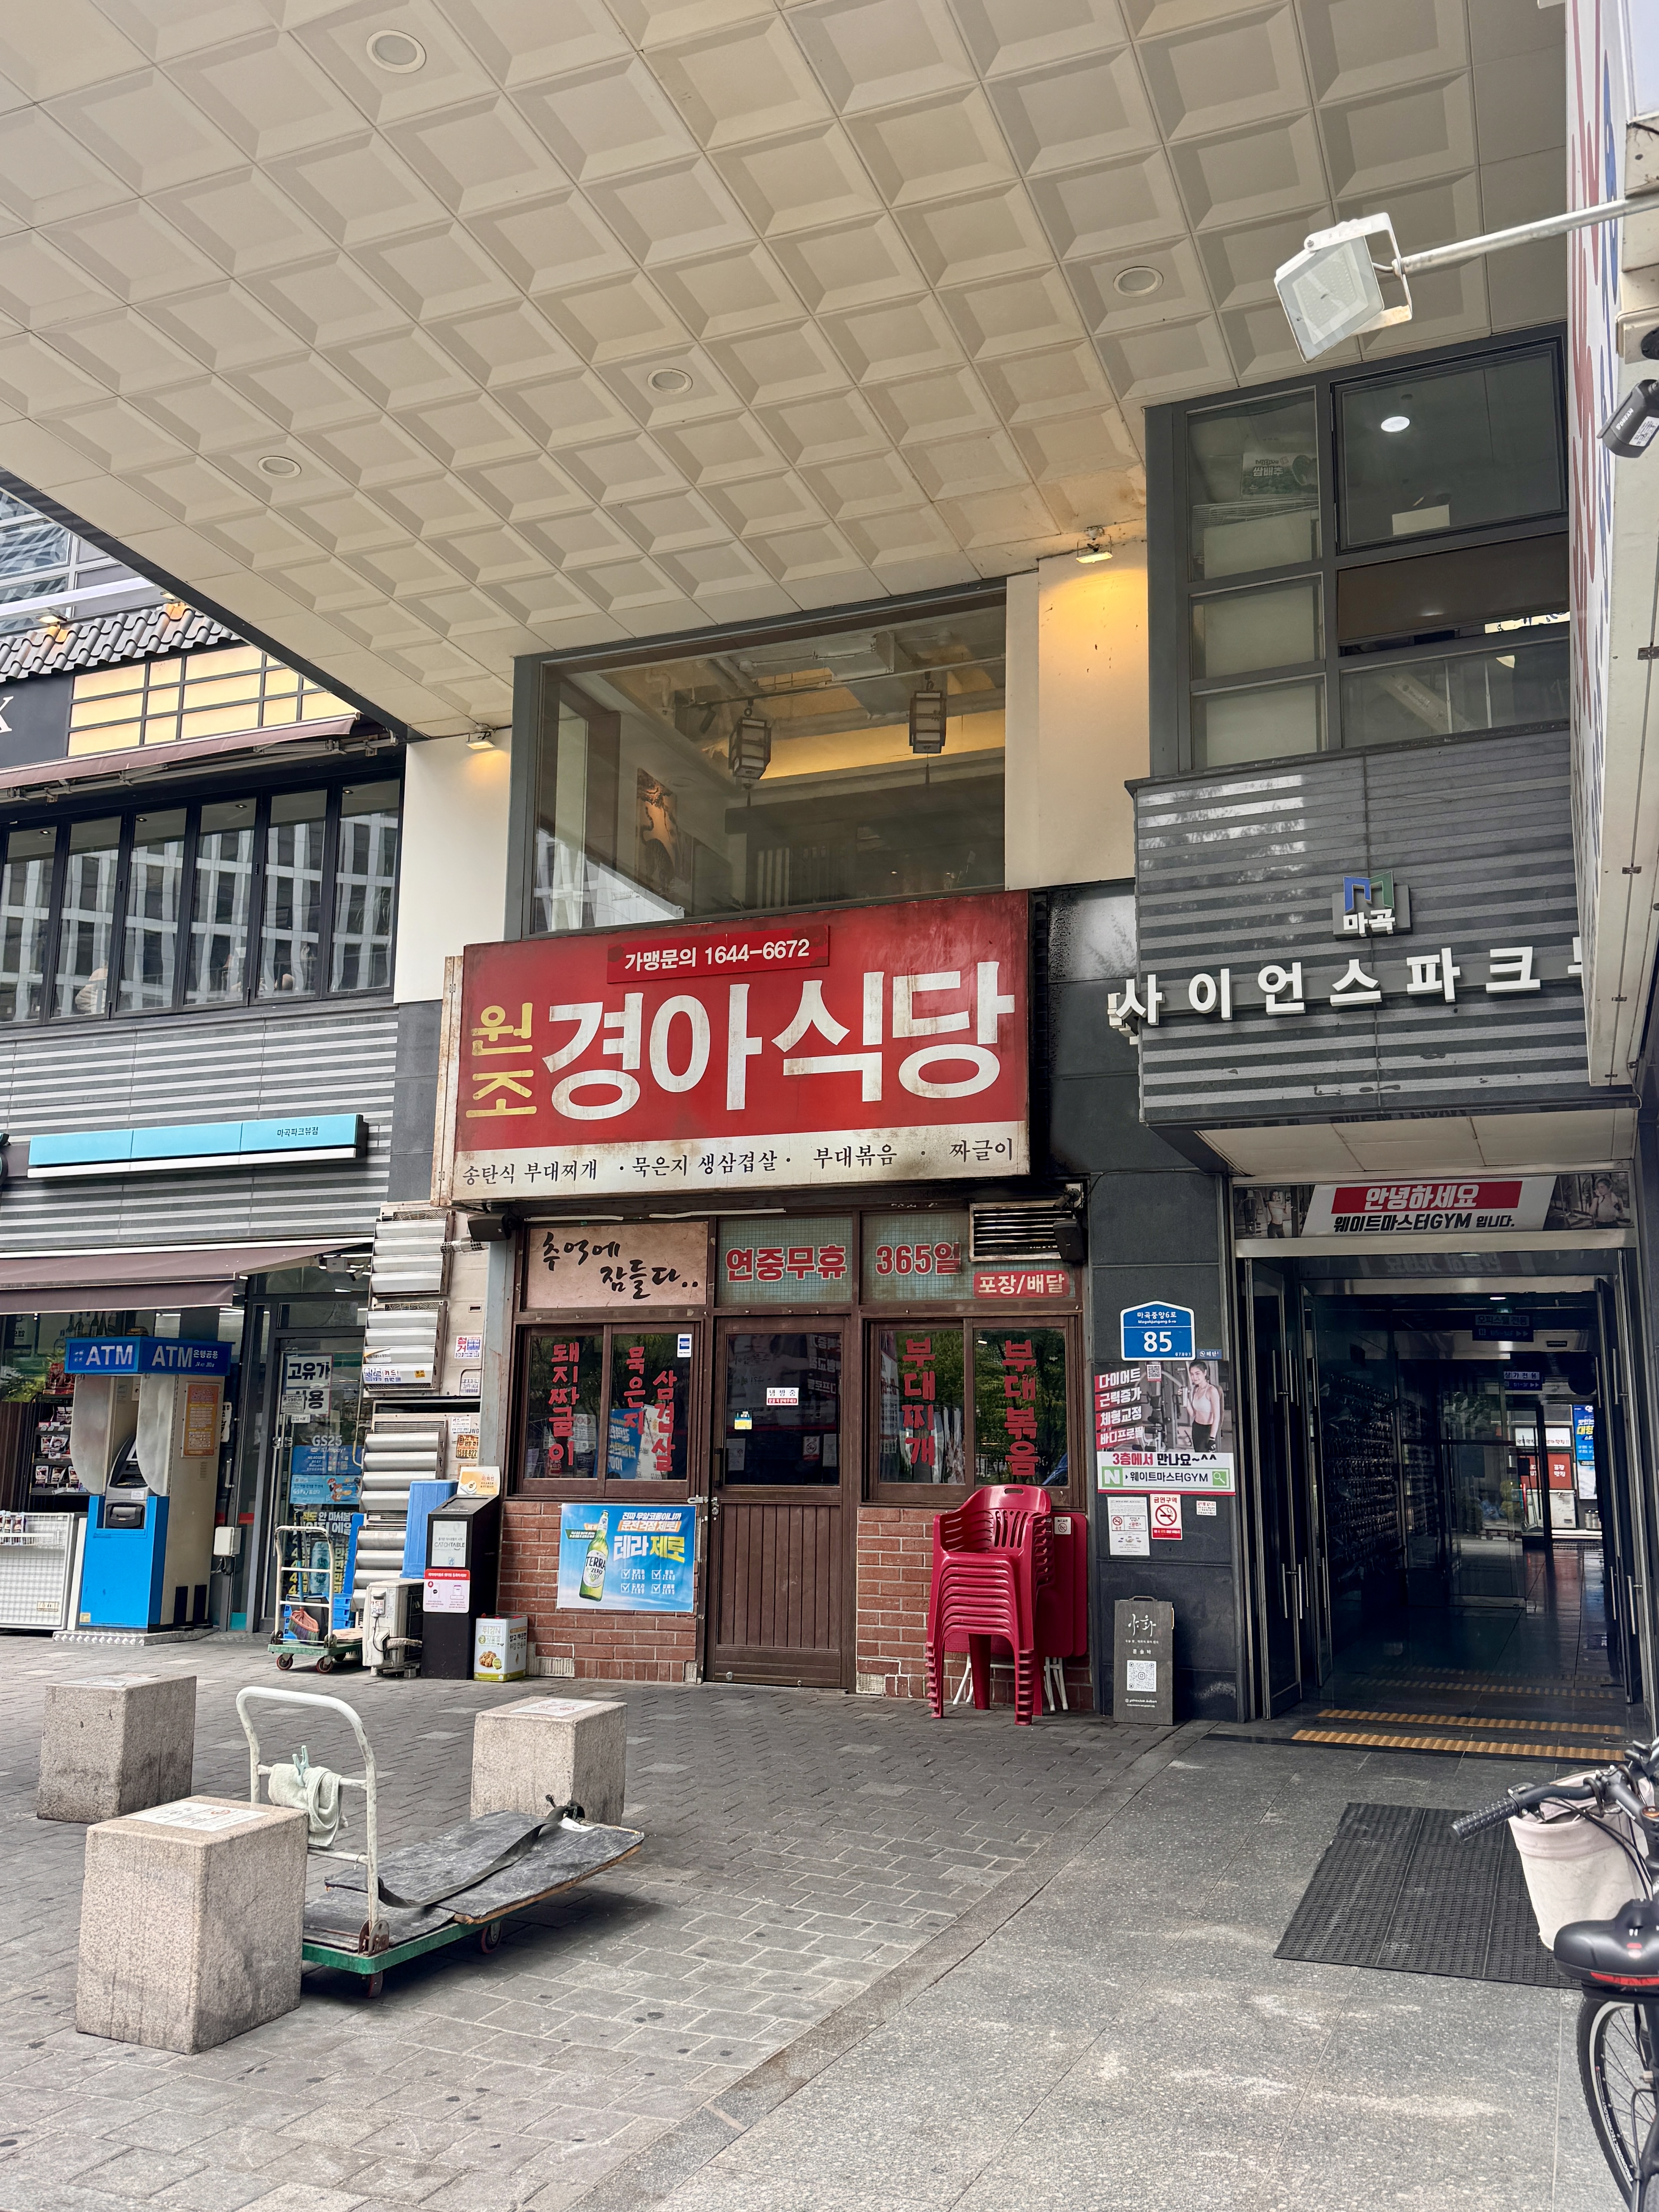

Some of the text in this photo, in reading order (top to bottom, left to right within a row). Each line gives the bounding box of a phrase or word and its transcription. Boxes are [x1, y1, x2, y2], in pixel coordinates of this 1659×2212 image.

[1253, 467, 1283, 476] 쌈배추
[1343, 909, 1395, 936] 마곡
[624, 938, 809, 972] 가맹문의 1644-6672
[542, 961, 1015, 1120] 경아식당
[466, 1002, 537, 1118] 원조
[277, 1127, 318, 1137] 마곡파크뷰점
[462, 1163, 516, 1185] 송탄식
[524, 1158, 598, 1183] 부대찌개
[814, 1143, 897, 1169] 부대볶음
[950, 1137, 1013, 1163] 짜글이
[1365, 1184, 1480, 1211] 안녕하세요
[1333, 1213, 1516, 1233] 웨이트마스터GYM 입니다.
[543, 1231, 620, 1271] 추억에
[875, 1241, 961, 1276] 365일
[726, 1243, 847, 1282] 연중무휴
[600, 1259, 698, 1299] 잠들다..
[978, 1273, 1066, 1295] 포장/배달
[1144, 1331, 1172, 1352] 85
[86, 1345, 133, 1365] ATM
[152, 1346, 193, 1367] ATM
[288, 1362, 330, 1380] 고유가
[1099, 1368, 1140, 1389] 다이어트
[624, 1346, 646, 1435] 묵은지
[902, 1337, 936, 1466] 부대찌개
[1099, 1387, 1142, 1408] 근력증가
[548, 1342, 579, 1466] 돼지짜글이
[1002, 1340, 1041, 1475] 부대볶음
[651, 1370, 677, 1471] 삼겹살
[1100, 1406, 1142, 1427] 체형교정
[312, 1435, 342, 1447] GS25
[1100, 1426, 1145, 1446] 바디프로필
[1113, 1453, 1153, 1466] 3층에서
[1104, 1470, 1208, 1484] N 웨이트마스터GYM
[318, 1512, 327, 1521] 안
[613, 1535, 685, 1563] 테라 제로
[586, 1556, 606, 1569] TERRA
